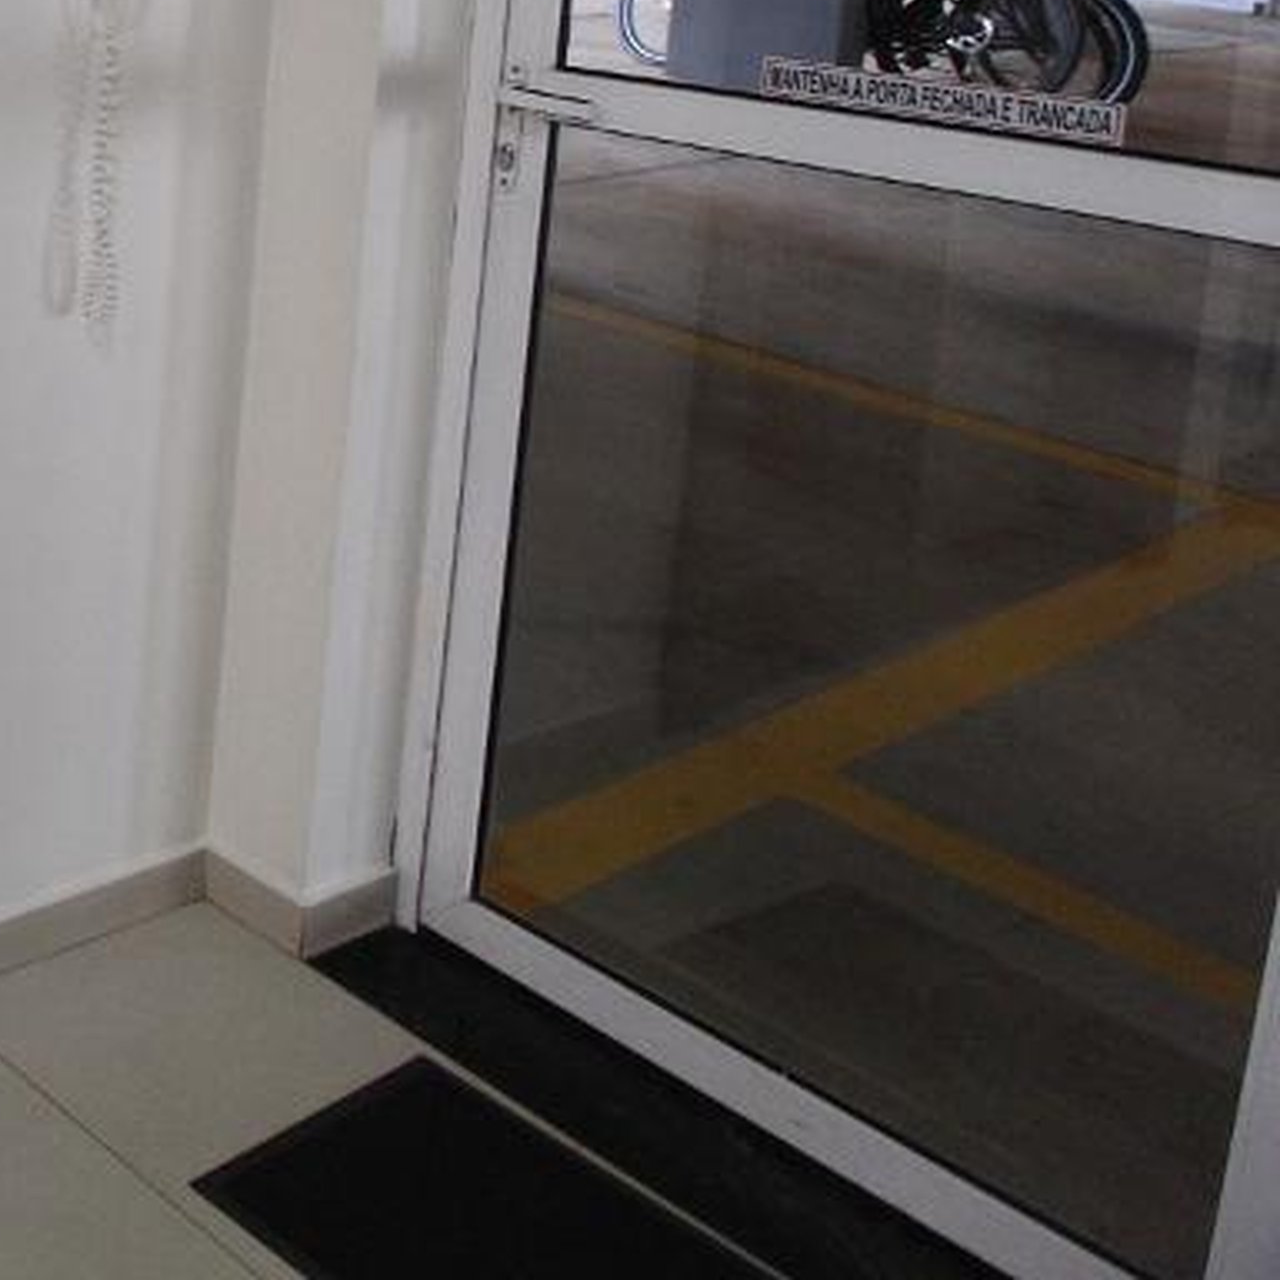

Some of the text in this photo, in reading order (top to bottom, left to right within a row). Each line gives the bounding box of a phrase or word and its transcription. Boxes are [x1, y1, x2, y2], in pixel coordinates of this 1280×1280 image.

[771, 66, 848, 96] MANTENHA
[849, 77, 863, 101] A
[866, 79, 917, 107] PORTA
[921, 85, 998, 119] FECHADA
[1001, 95, 1014, 122] E
